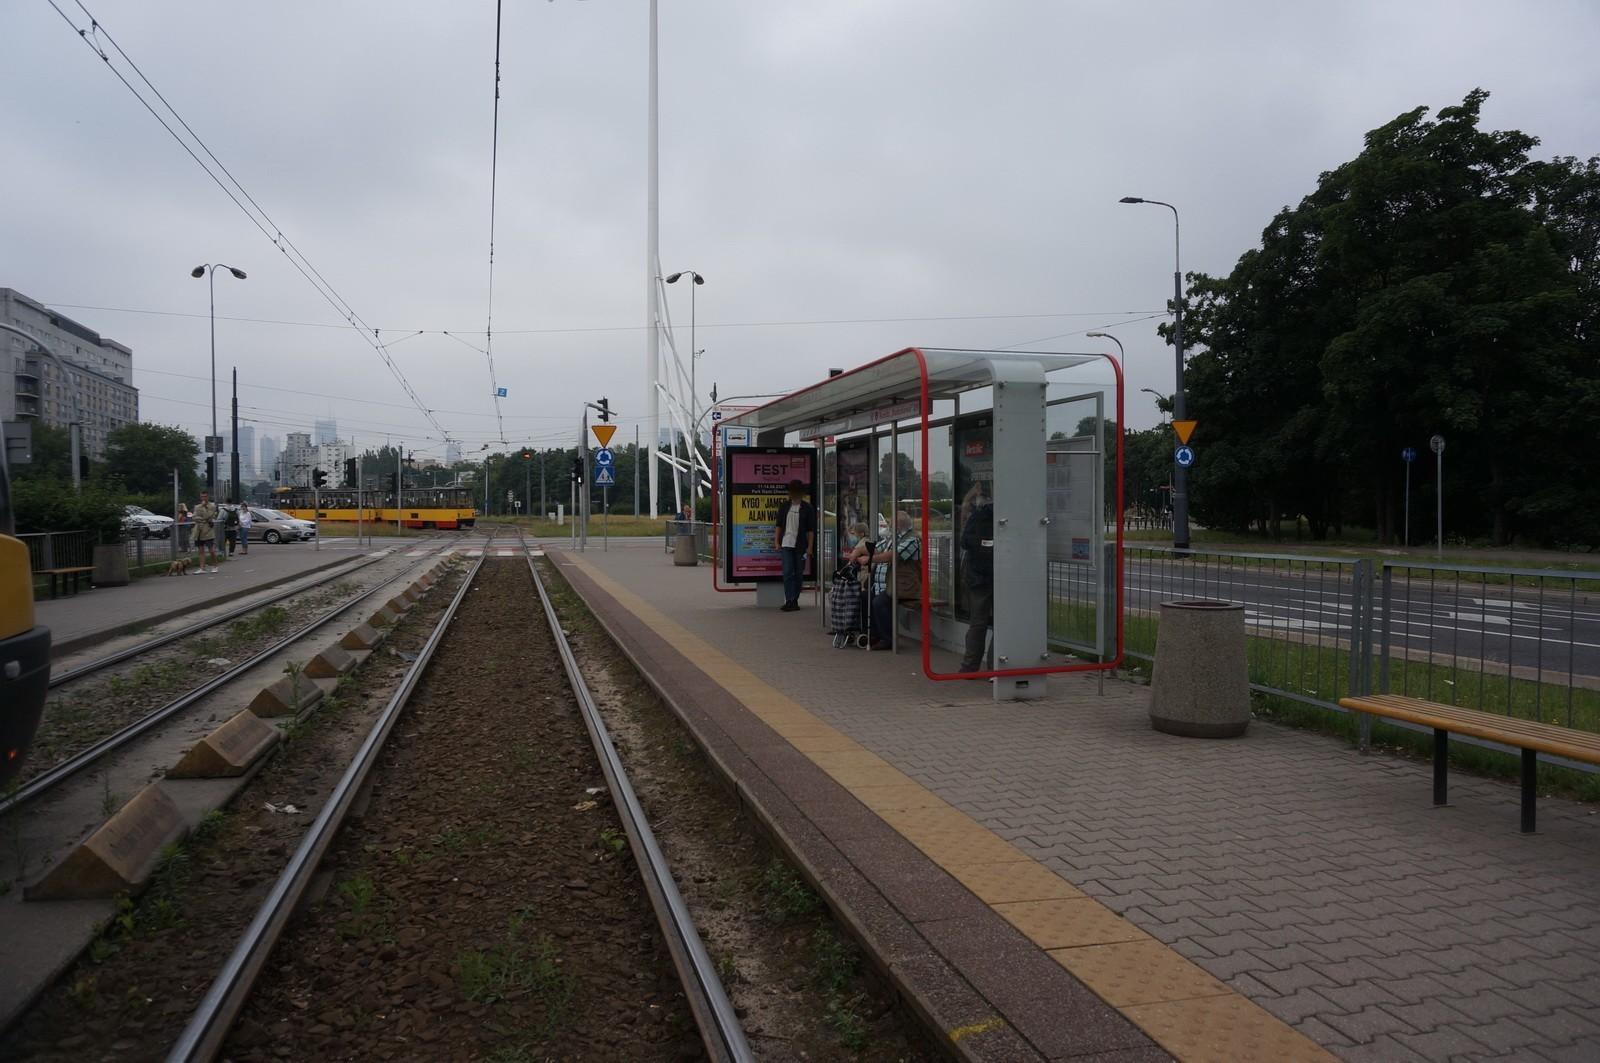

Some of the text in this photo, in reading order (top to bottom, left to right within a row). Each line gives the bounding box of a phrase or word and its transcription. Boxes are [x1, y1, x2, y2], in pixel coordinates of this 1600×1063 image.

[753, 464, 789, 476] FEST
[741, 497, 760, 509] KYGO
[748, 510, 766, 521] ALAN
